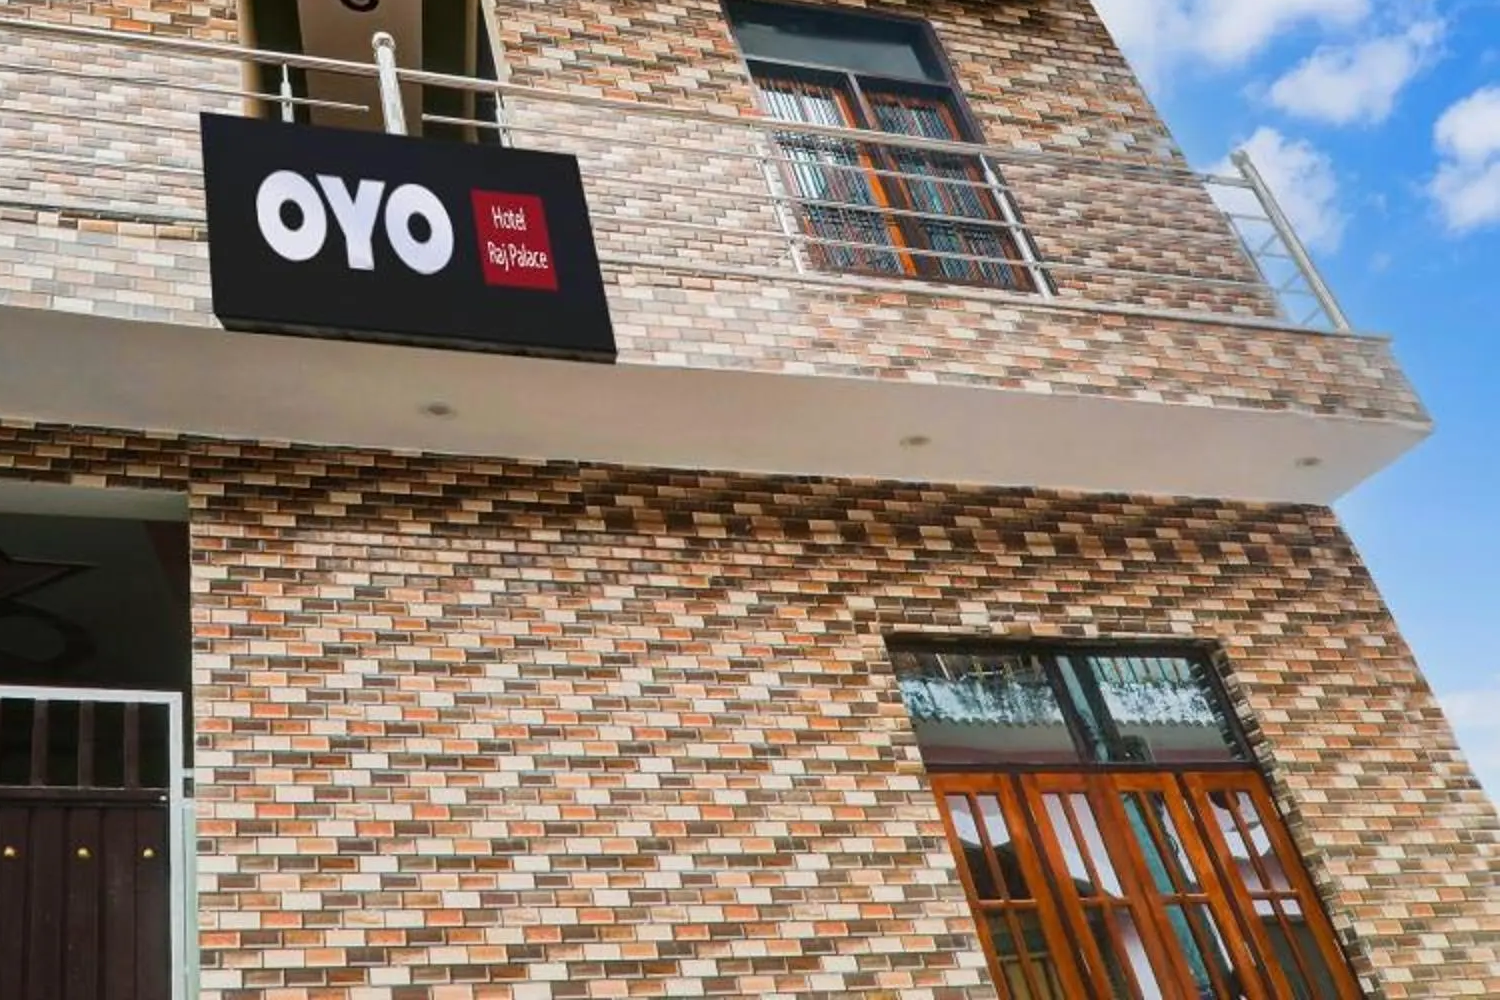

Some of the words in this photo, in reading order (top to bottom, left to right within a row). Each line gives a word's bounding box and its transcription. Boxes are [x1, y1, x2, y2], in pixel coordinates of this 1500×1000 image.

[255, 169, 455, 275] OYO
[491, 205, 527, 231] Hotel
[487, 241, 509, 272] Raj
[507, 242, 549, 269] Palace
